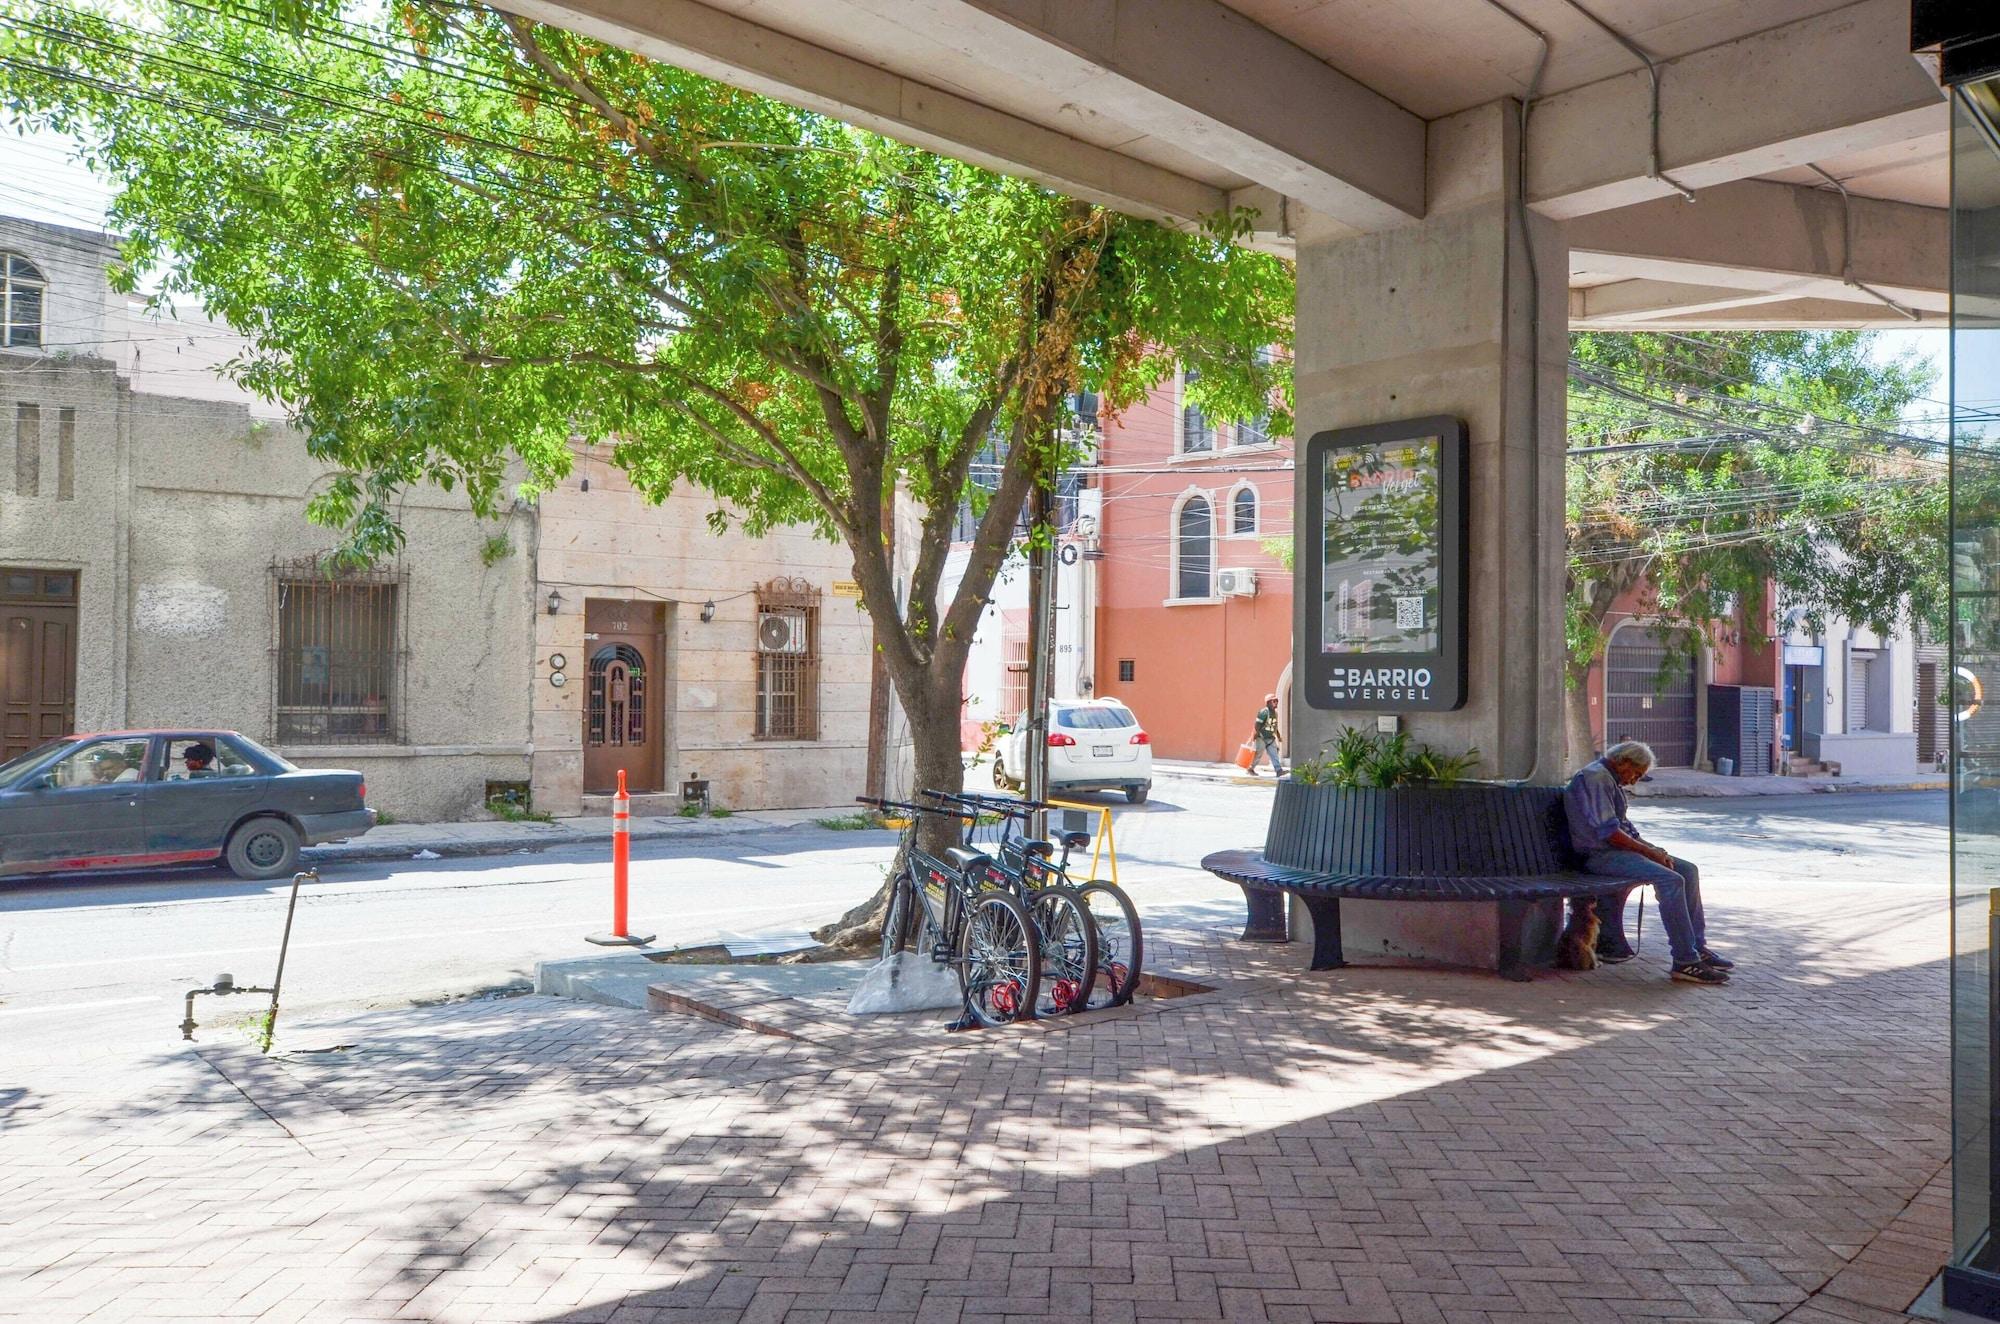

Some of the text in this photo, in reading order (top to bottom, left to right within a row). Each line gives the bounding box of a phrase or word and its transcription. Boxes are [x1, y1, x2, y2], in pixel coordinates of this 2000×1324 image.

[612, 621, 628, 631] 702
[1059, 645, 1072, 654] 895
[1347, 667, 1431, 687] BARRIO
[1347, 688, 1430, 700] VERGEL
